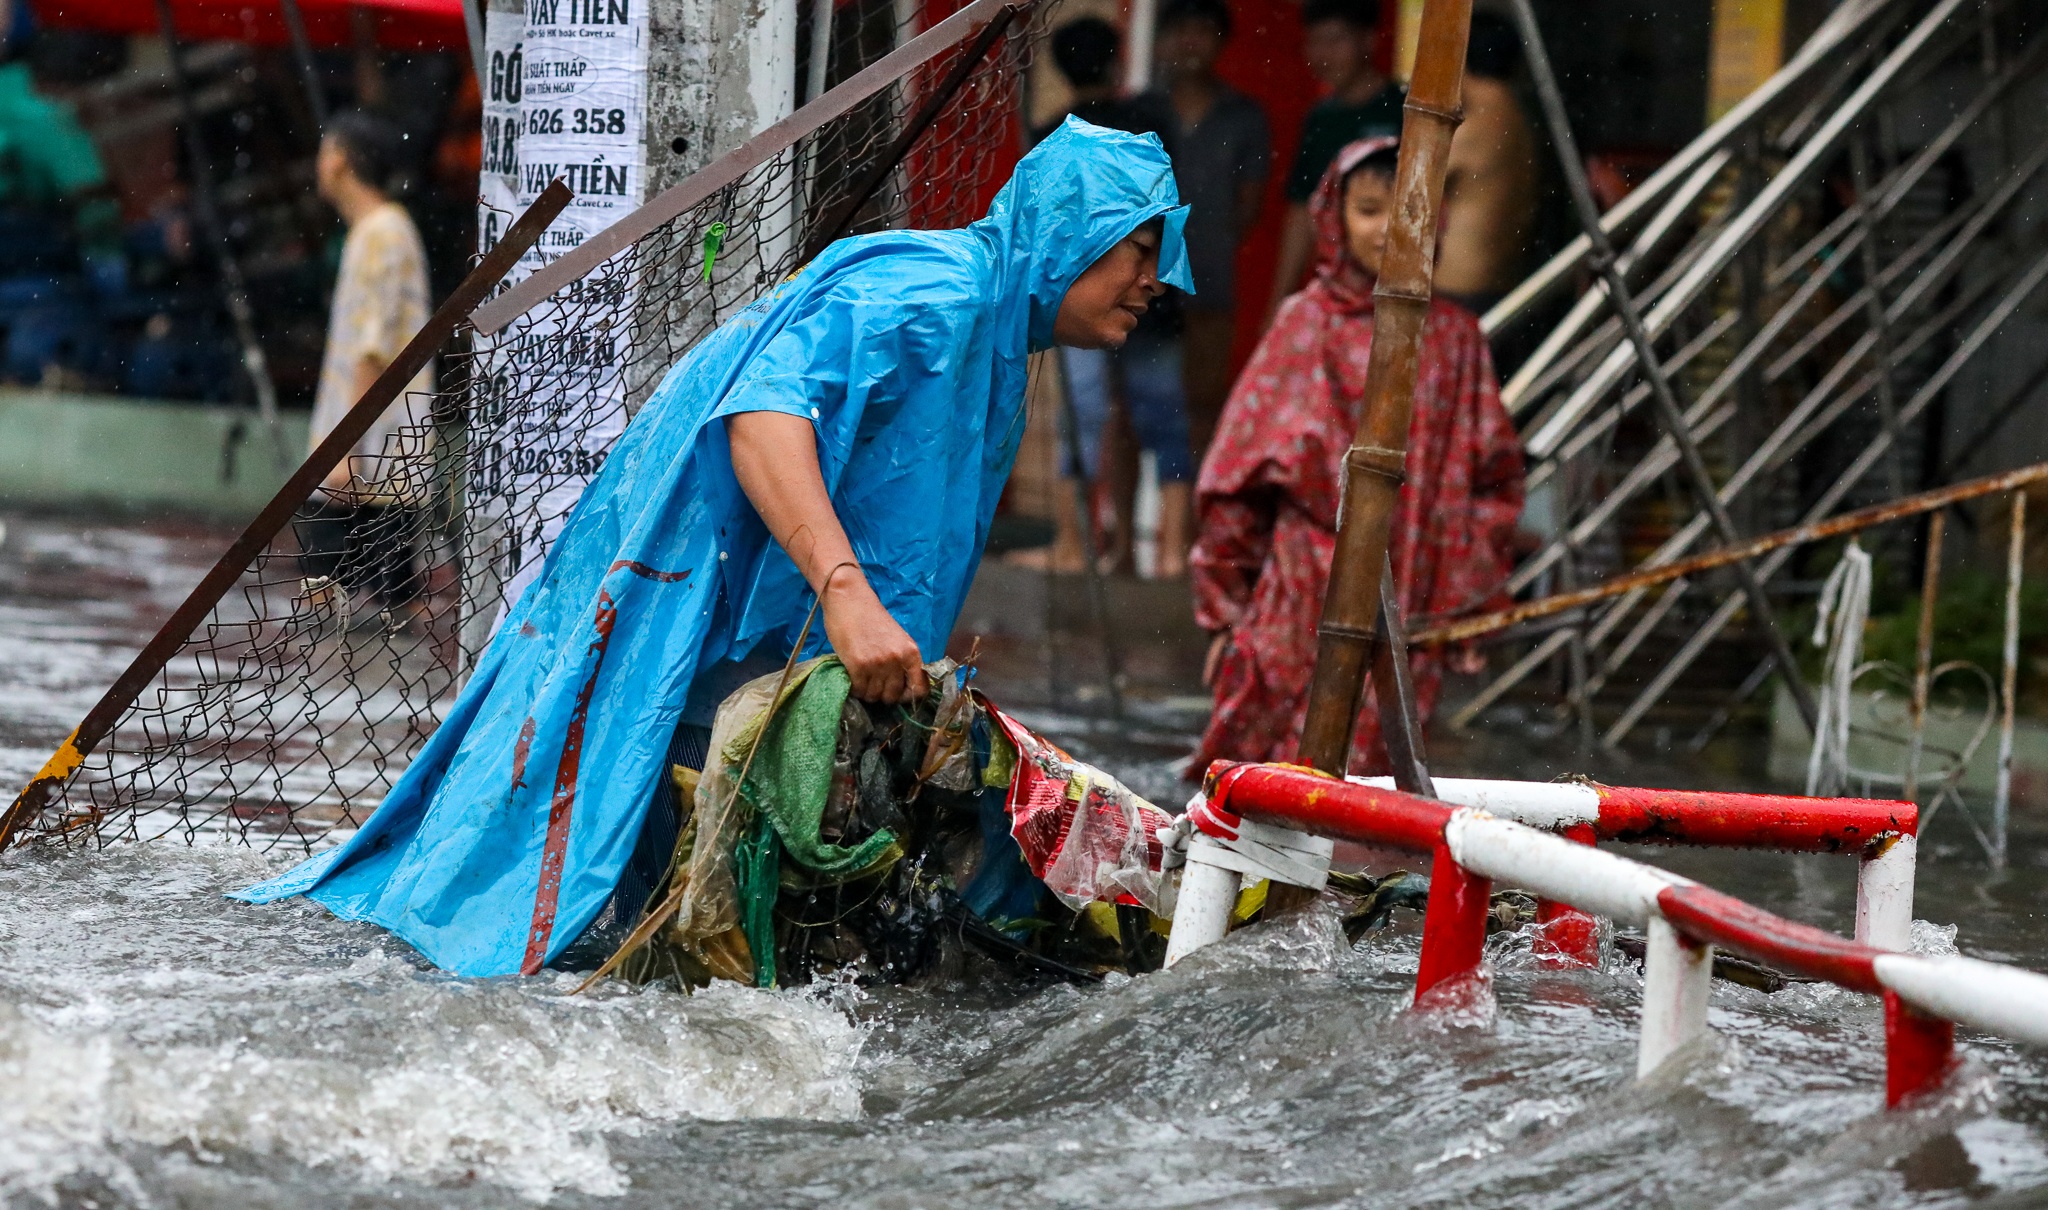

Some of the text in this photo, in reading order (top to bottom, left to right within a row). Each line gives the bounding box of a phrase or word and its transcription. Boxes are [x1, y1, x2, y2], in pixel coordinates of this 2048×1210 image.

[531, 0, 558, 25] VAY
[579, 28, 603, 38] Cavet
[606, 30, 616, 38] xe
[553, 56, 587, 77] THẤP
[553, 82, 576, 93] NGAY
[529, 108, 564, 135] 626
[571, 108, 626, 135] 358
[526, 163, 558, 194] VAY
[565, 154, 627, 196] TIỀN
[576, 199, 601, 208] Cavet
[603, 200, 613, 209] xe
[551, 227, 584, 246] THẤP
